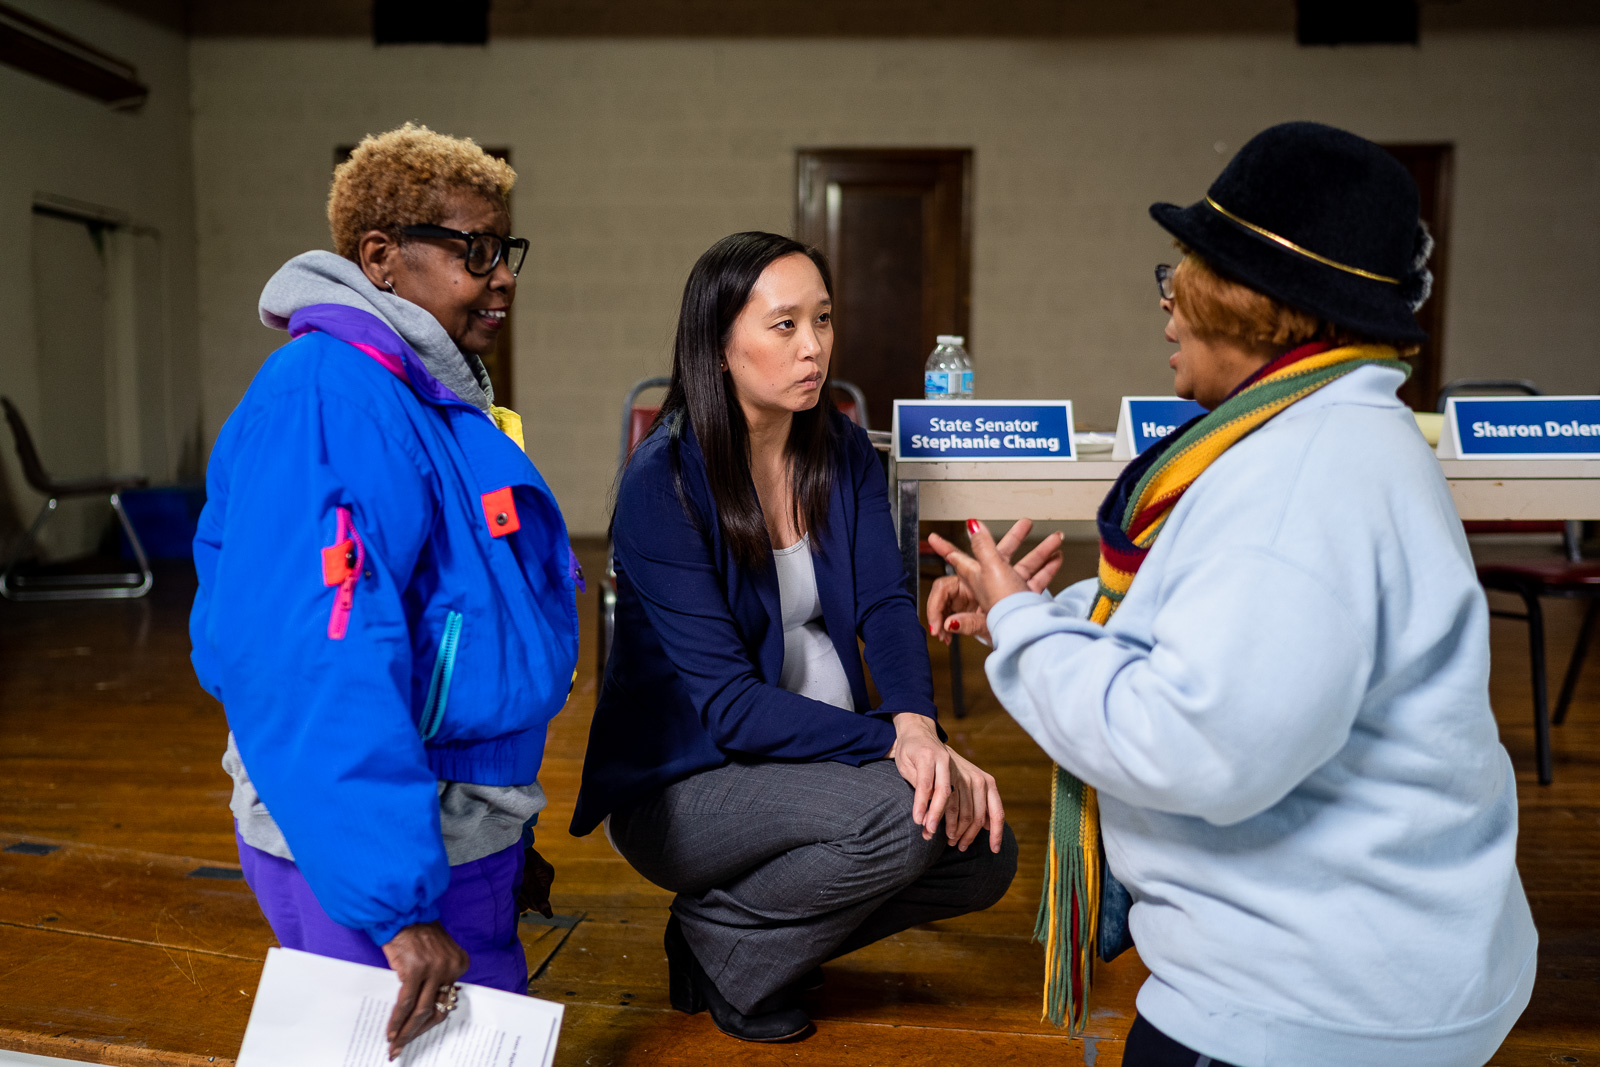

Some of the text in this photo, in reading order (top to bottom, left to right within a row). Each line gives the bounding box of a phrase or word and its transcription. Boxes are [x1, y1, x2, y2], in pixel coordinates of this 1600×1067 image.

[930, 418, 1039, 432] State Senator
[1141, 422, 1178, 438] Hea
[1472, 420, 1600, 438] Sharon Dolen
[911, 434, 1060, 452] Stephanie Chang
